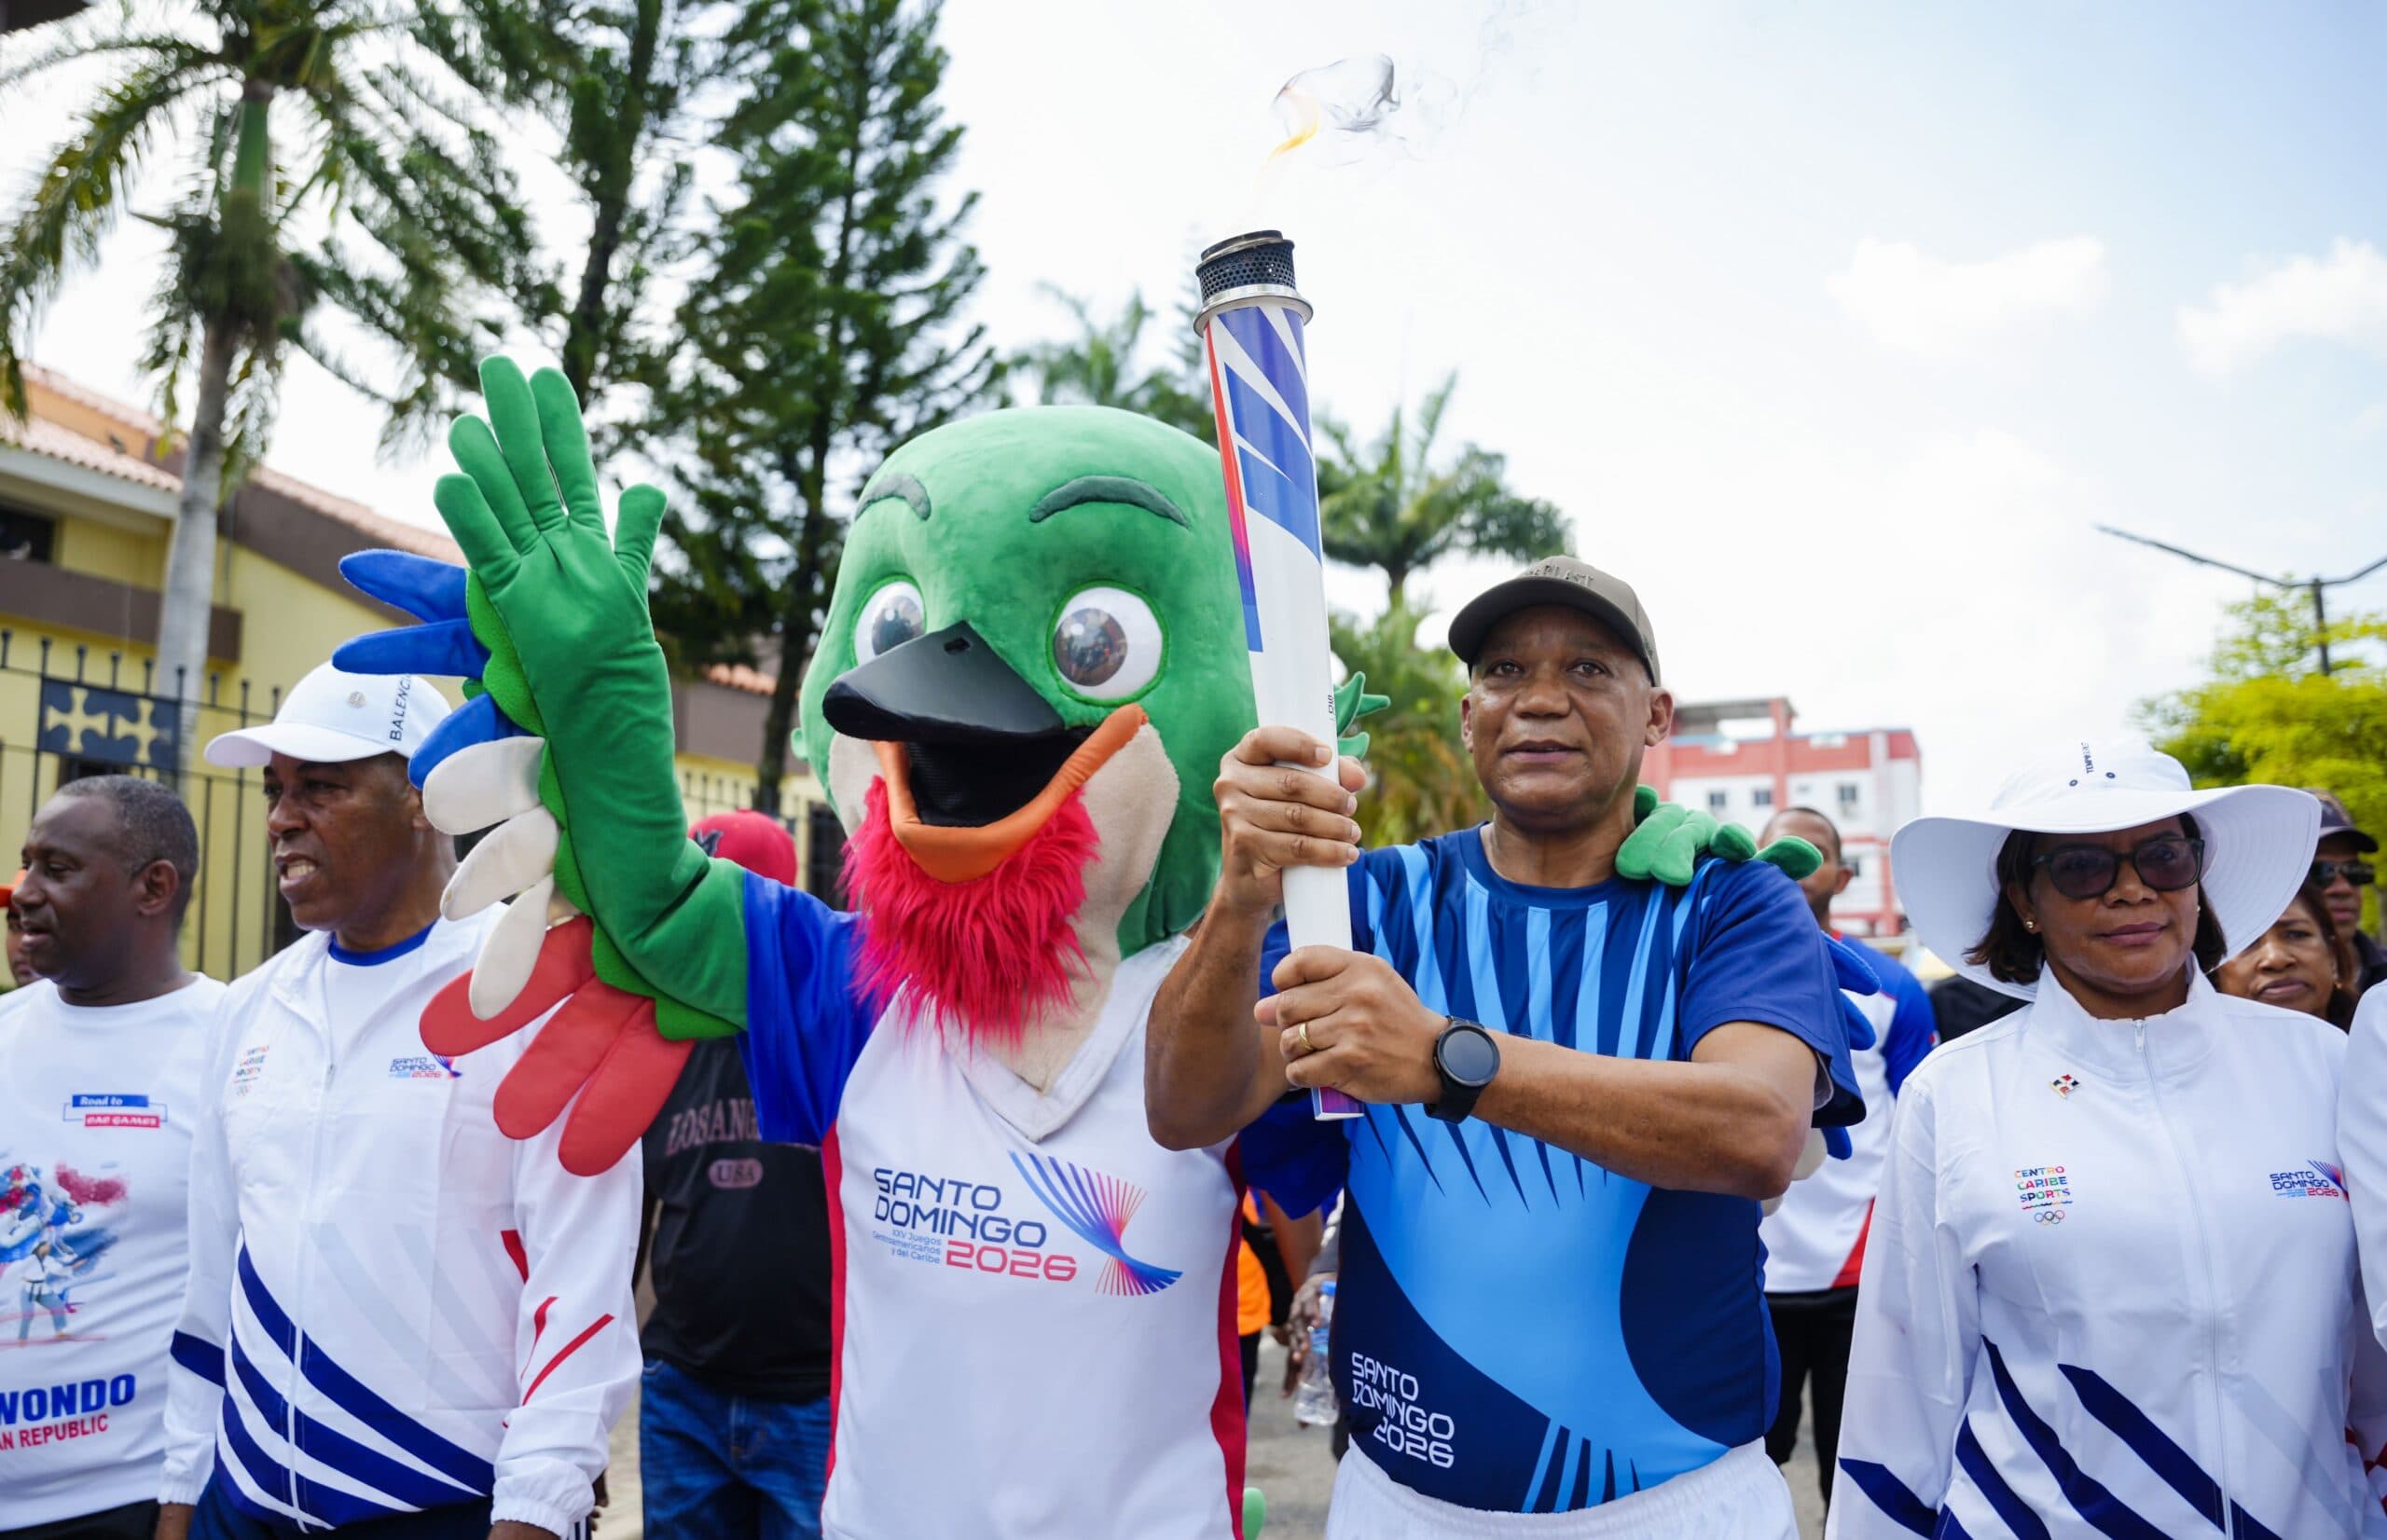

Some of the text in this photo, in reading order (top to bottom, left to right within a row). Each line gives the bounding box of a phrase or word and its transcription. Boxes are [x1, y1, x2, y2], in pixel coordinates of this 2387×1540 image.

[716, 1164, 756, 1183] USA
[2014, 1165, 2065, 1178] CENTRO
[2017, 1176, 2068, 1190] CARIBE
[2270, 1171, 2315, 1182] SANTO
[2272, 1179, 2330, 1190] DOMINGO
[873, 1167, 1002, 1212] SANTO
[2020, 1188, 2072, 1203] SPORTS
[874, 1194, 1047, 1248] DOMINGO
[910, 1250, 942, 1265] Caribe
[945, 1240, 1078, 1283] 2026
[1351, 1352, 1419, 1402] SANTO
[1352, 1379, 1456, 1441] DOMINGO
[19, 1413, 109, 1448] REPUBLIC
[1373, 1416, 1456, 1469] 2026
